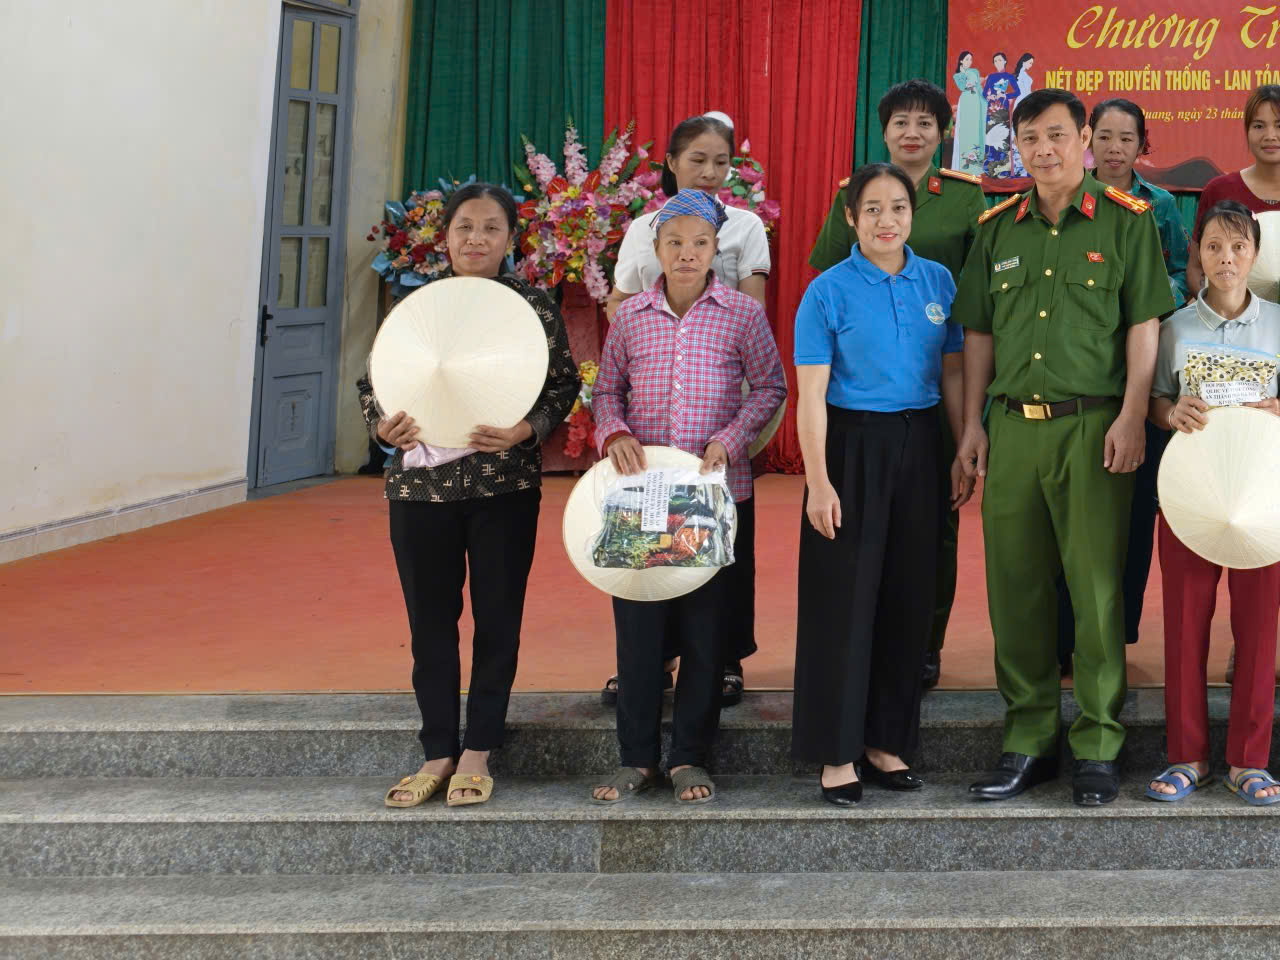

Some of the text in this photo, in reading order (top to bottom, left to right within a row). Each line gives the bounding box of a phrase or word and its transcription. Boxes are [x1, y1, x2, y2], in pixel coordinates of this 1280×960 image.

[1065, 4, 1222, 61] Chương
[1045, 66, 1073, 91] NÉT
[1075, 69, 1104, 96] ĐẸP
[1107, 63, 1161, 91] TRUYỀN
[1164, 62, 1211, 91] THỐNG
[1224, 70, 1252, 91] LAN
[1254, 63, 1280, 87] TỎA
[1141, 107, 1174, 123] uang,
[1177, 108, 1203, 122] ngày
[1205, 107, 1219, 120] 23
[1221, 107, 1246, 120] thán
